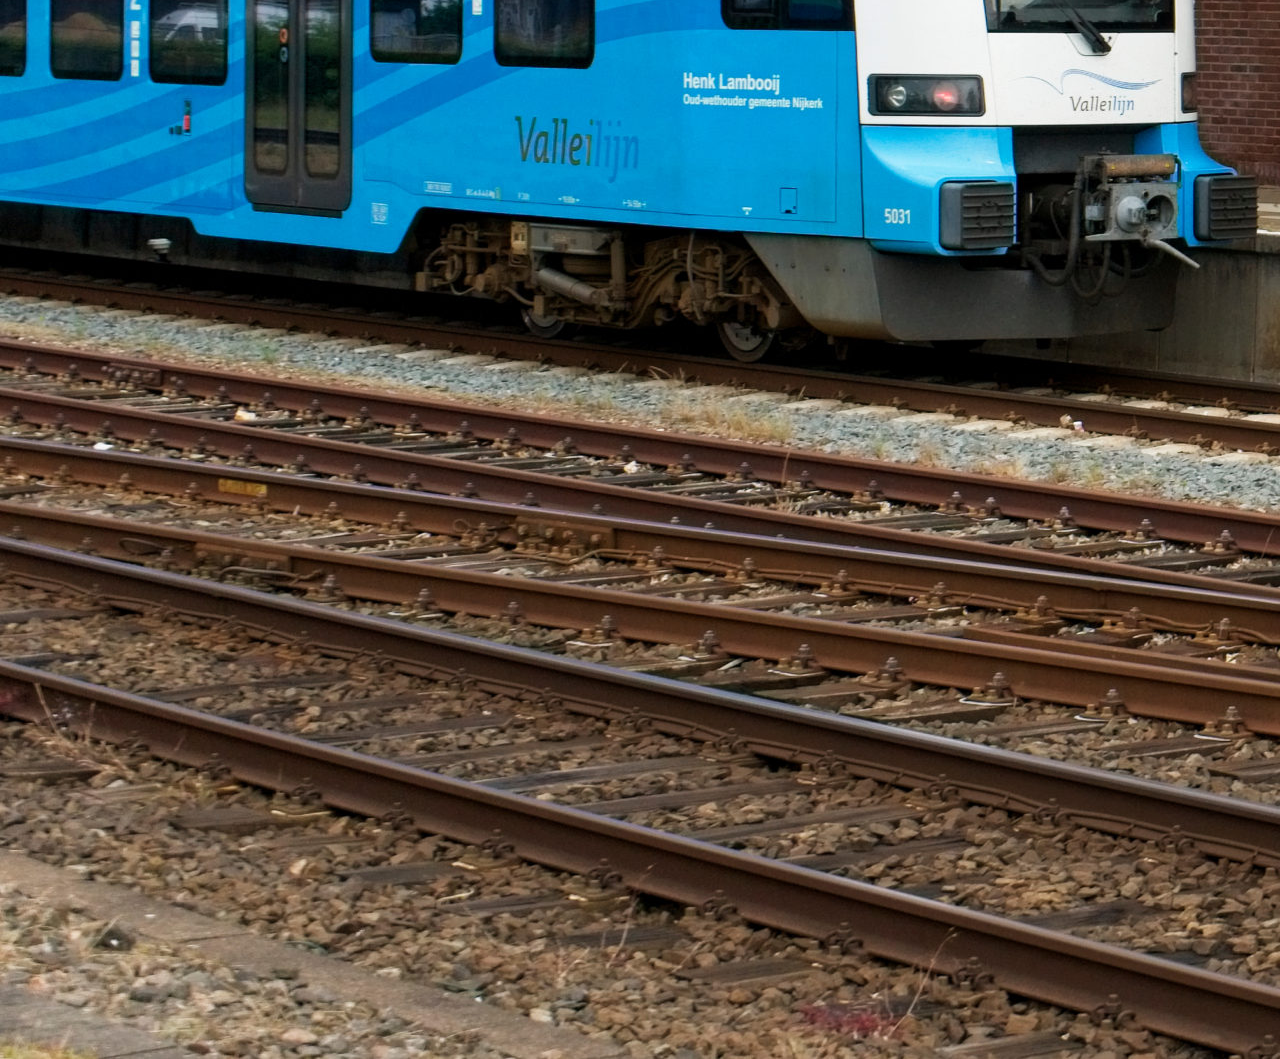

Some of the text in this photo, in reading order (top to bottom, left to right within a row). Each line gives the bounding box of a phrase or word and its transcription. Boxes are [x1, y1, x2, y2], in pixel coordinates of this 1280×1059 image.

[683, 72, 780, 96] Henk Lambooij
[683, 93, 823, 111] Oud-wethouder gemeente Nijkerk
[1068, 95, 1136, 116] Valleilijn
[515, 115, 640, 184] Valleilijn
[884, 208, 911, 224] 5031
